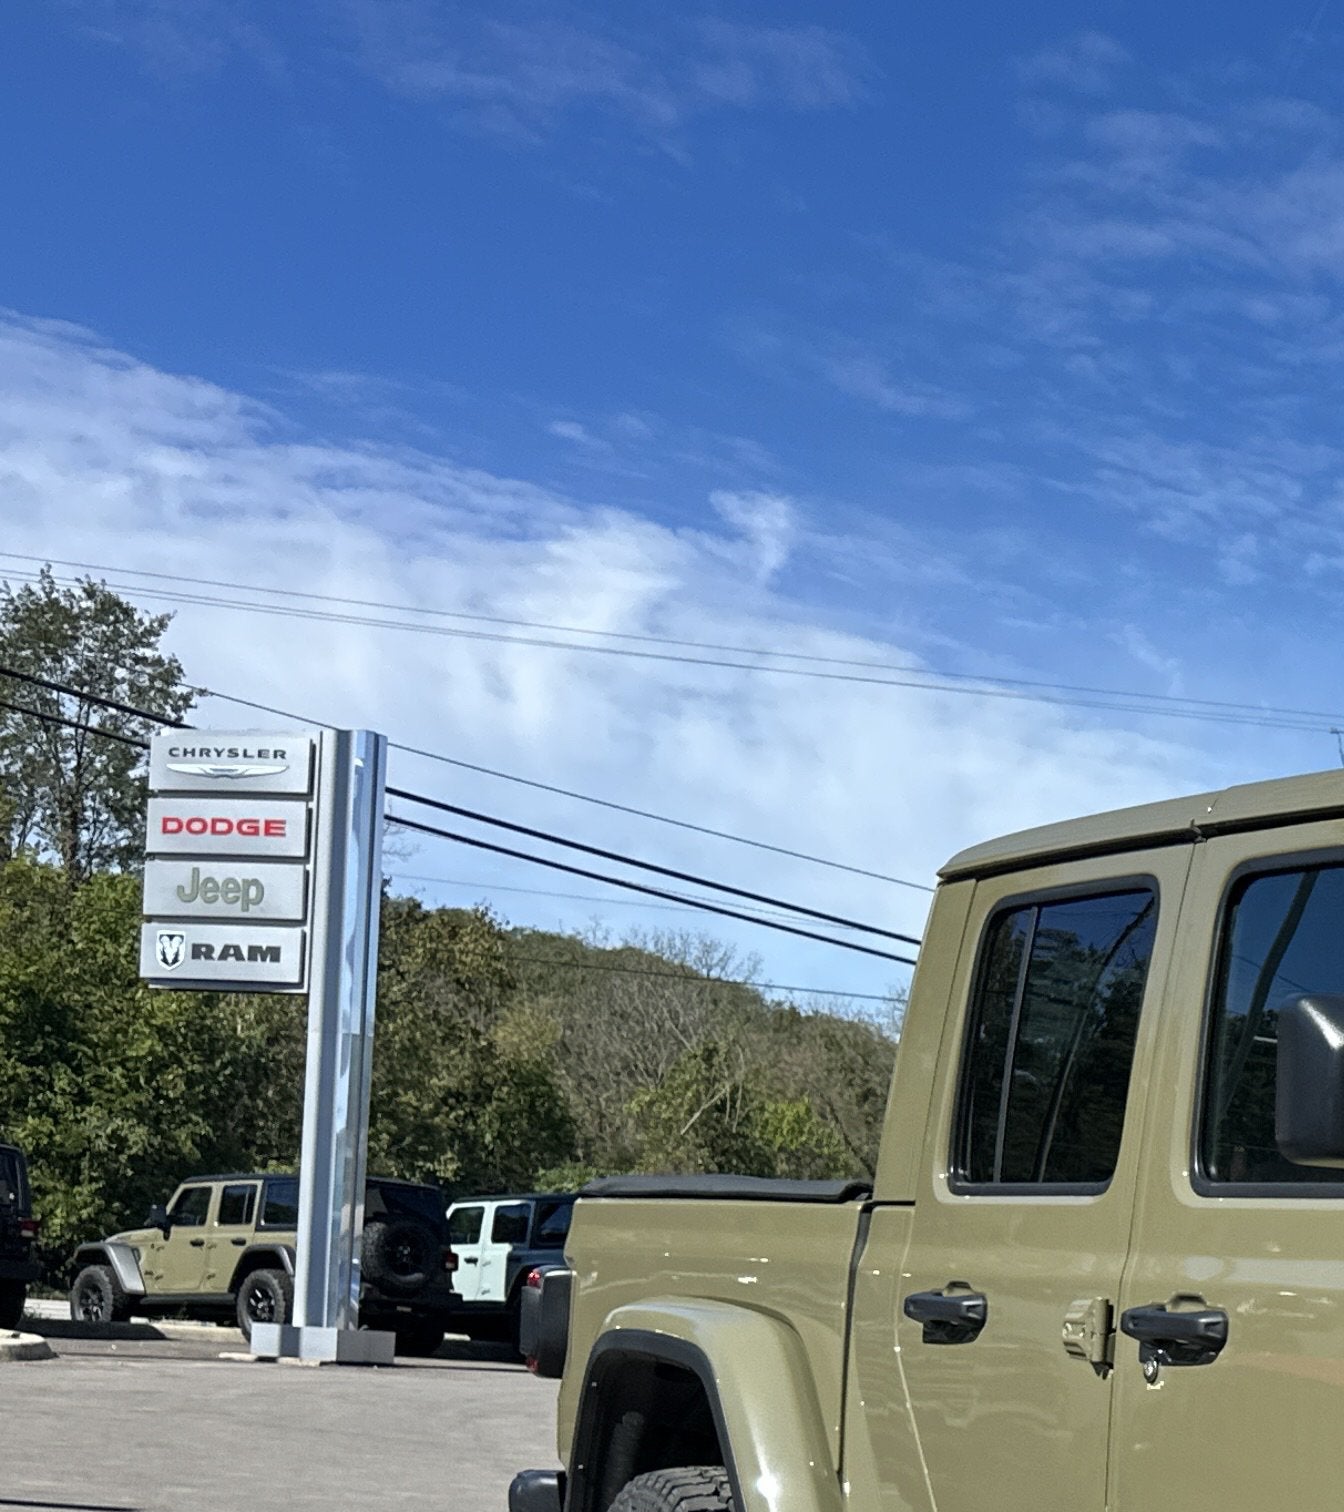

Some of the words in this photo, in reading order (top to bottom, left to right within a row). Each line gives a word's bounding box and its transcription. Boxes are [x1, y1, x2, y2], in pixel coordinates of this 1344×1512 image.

[168, 747, 287, 760] CHRYSLER
[161, 817, 287, 837] DODGE
[176, 867, 265, 912] Jeep
[191, 942, 281, 963] RAM
